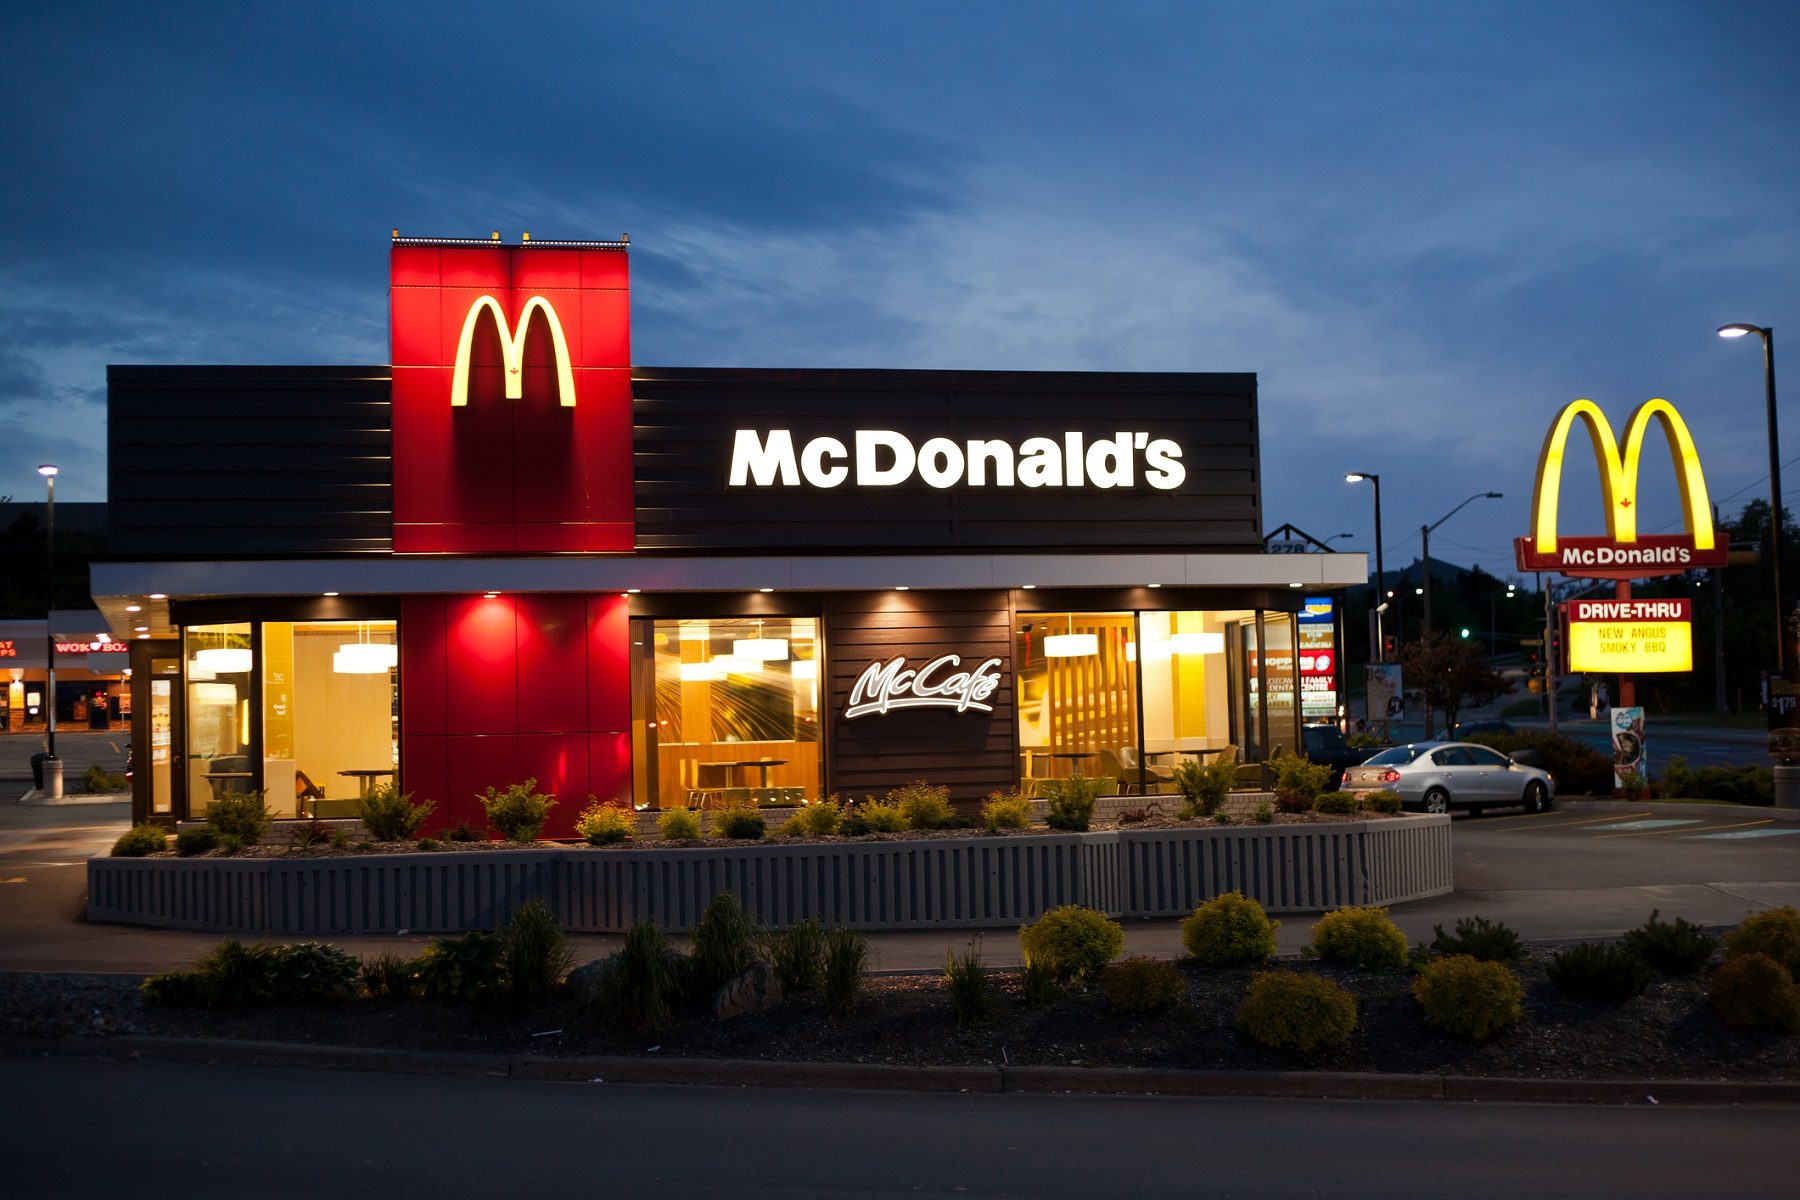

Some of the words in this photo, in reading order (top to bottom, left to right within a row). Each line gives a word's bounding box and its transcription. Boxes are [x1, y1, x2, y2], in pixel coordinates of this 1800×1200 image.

[728, 429, 1187, 489] McDonald's
[1562, 547, 1691, 564] McDonald's
[1579, 603, 1682, 619] DRIVE-THRU
[1599, 628, 1623, 638] NEW
[1631, 628, 1666, 638] ANGUS
[56, 643, 90, 652] WOK
[1600, 643, 1637, 653] SMOKY
[1645, 642, 1666, 653] BBQ
